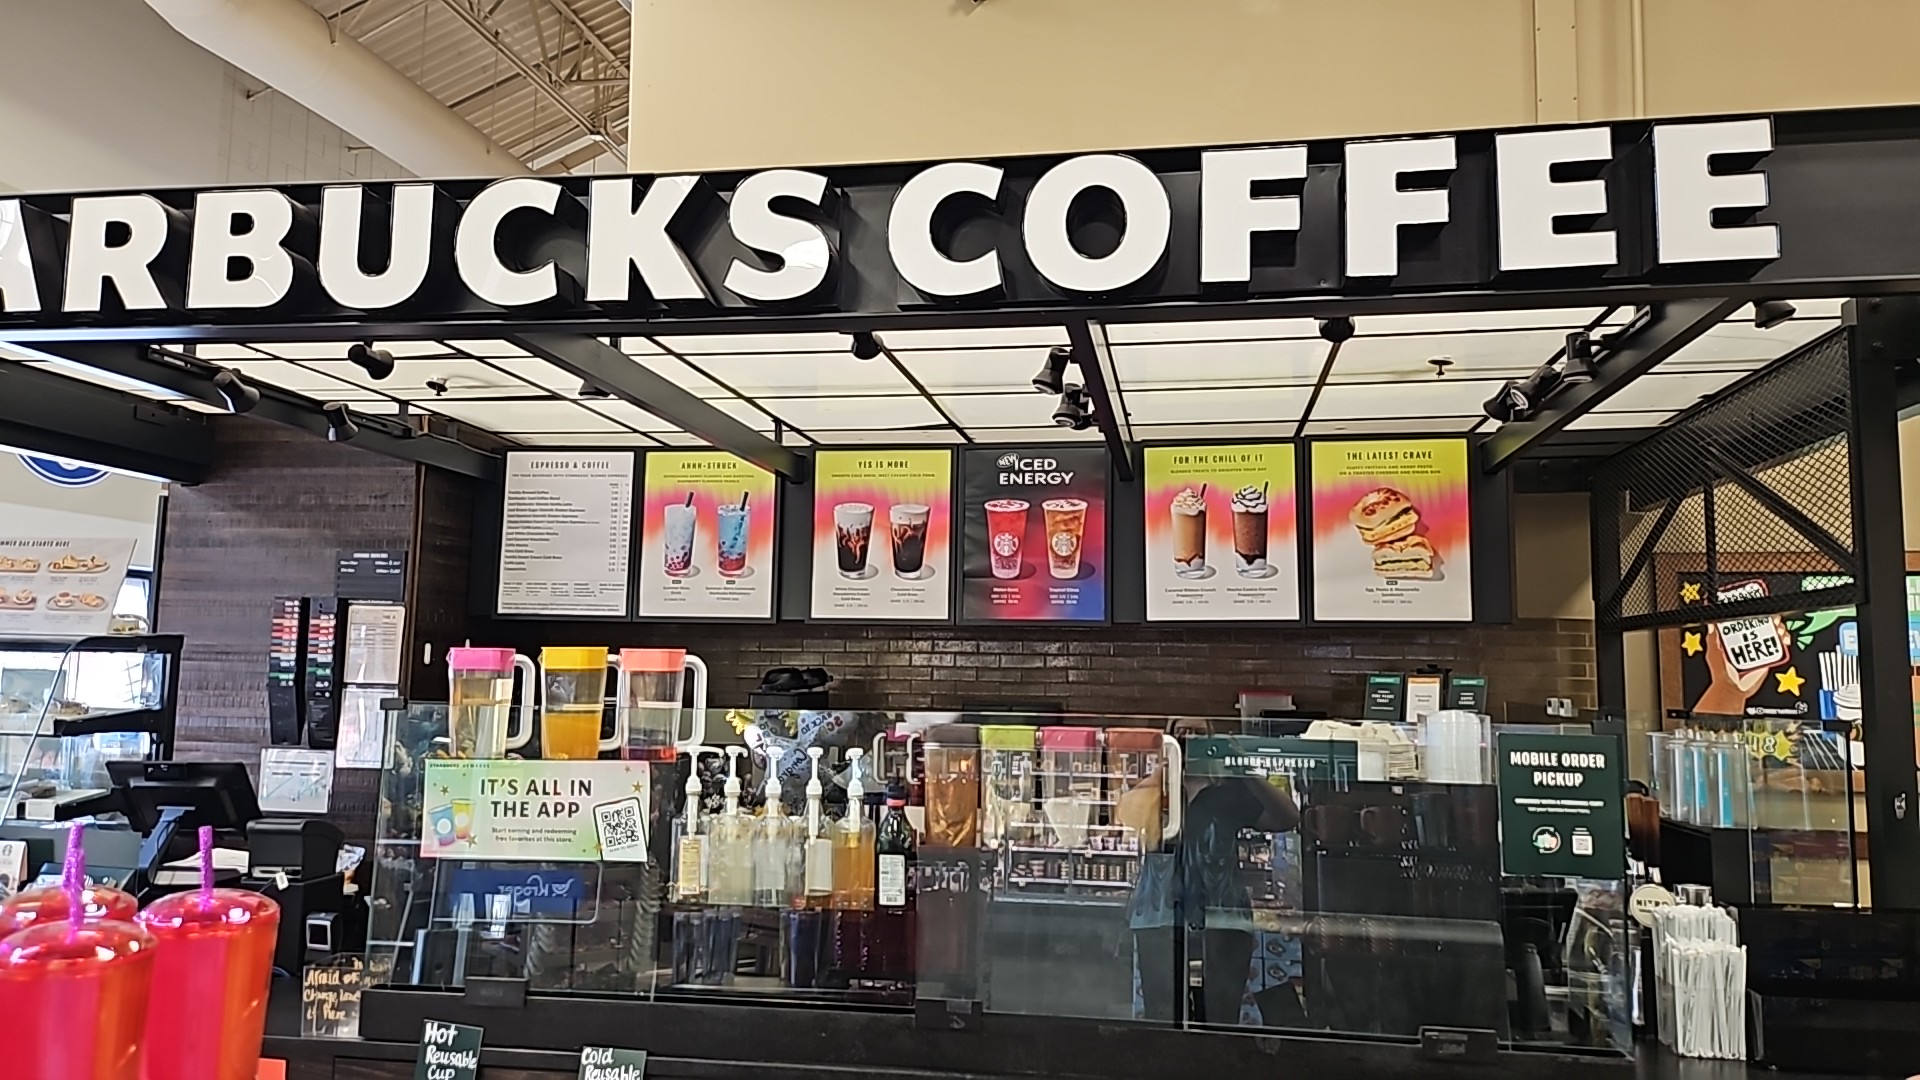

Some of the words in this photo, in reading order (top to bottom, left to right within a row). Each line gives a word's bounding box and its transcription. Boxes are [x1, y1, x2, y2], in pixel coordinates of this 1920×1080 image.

[888, 117, 1779, 296] COFFEE
[998, 454, 1018, 466] NEW
[1014, 458, 1056, 470] ICED
[1174, 456, 1190, 464] FOR
[1194, 456, 1208, 464] THE
[1213, 455, 1237, 463] CHILL
[1241, 454, 1250, 462] OF
[1255, 454, 1263, 462] IT
[1346, 452, 1363, 460] THE
[1366, 452, 1399, 460] LATEST
[1402, 452, 1432, 460] CRAVE
[530, 461, 570, 469] ESPRESSO
[573, 461, 578, 469] &
[581, 461, 610, 469] COFFEE
[858, 461, 873, 469] YES
[875, 461, 884, 469] IS
[887, 461, 909, 469] MORE
[999, 472, 1074, 485] ENERGY
[1742, 631, 1758, 642] IS
[1731, 636, 1779, 664] HERE!
[1510, 752, 1558, 767] MOBILE
[1561, 753, 1605, 769] ORDER
[480, 779, 518, 796] IT'S
[525, 779, 562, 796] ALL
[570, 779, 592, 796] IN
[1533, 772, 1584, 787] PICKUP
[490, 801, 530, 818] THE
[536, 801, 580, 818] APP
[424, 1022, 458, 1047] Hot
[425, 1044, 478, 1070] Reusable
[581, 1047, 615, 1066] Cold
[427, 1064, 456, 1080] Cup
[584, 1064, 640, 1080] Reusable
